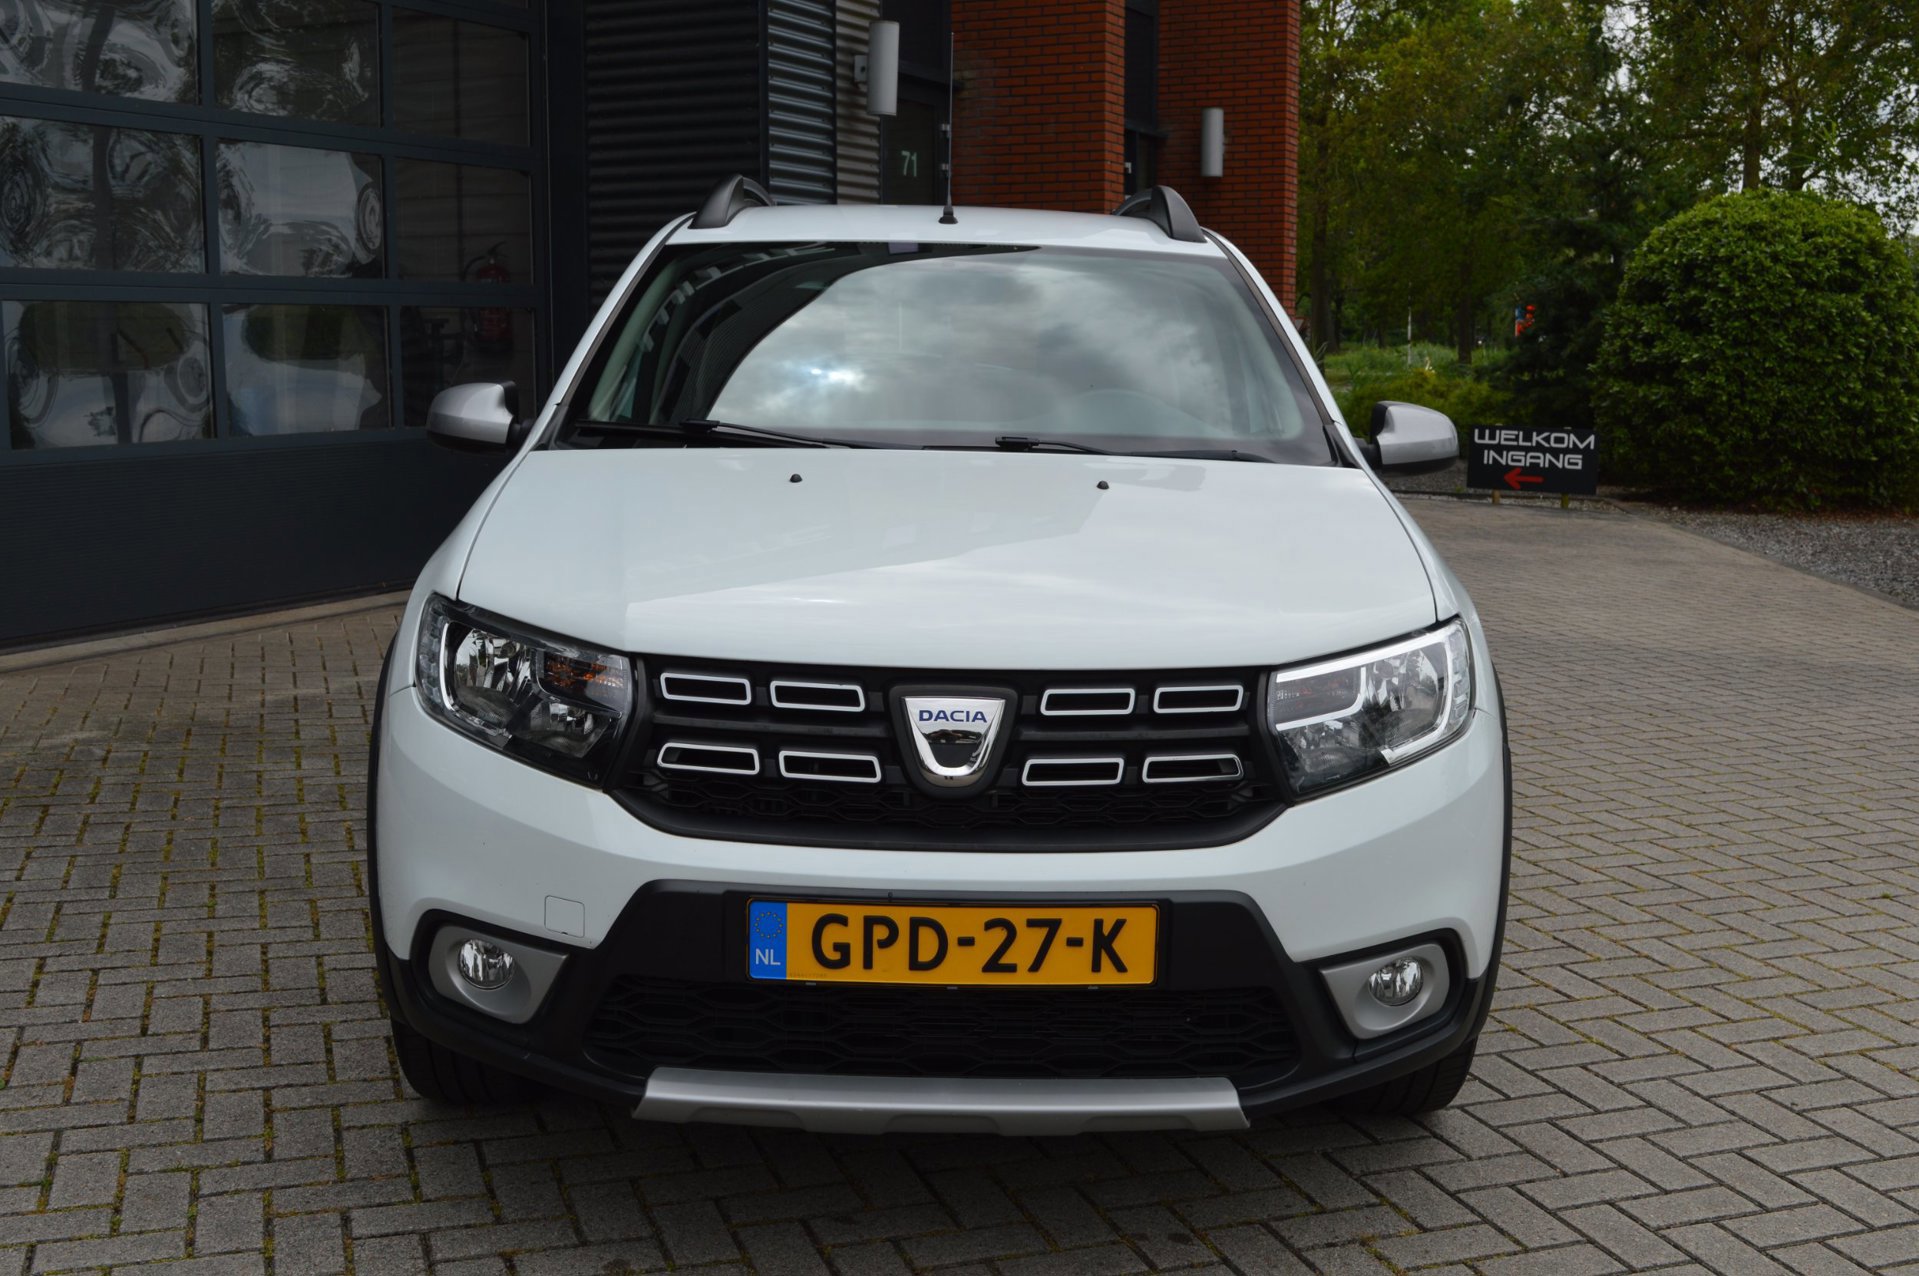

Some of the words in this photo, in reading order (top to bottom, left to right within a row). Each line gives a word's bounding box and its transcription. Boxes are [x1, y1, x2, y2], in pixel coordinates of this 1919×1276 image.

[901, 150, 917, 177] 71
[1474, 428, 1595, 450] WELKOM
[1483, 449, 1583, 470] INGANG
[918, 709, 987, 723] DACIA
[811, 913, 1129, 974] GPD-27-K
[754, 948, 781, 966] NL
